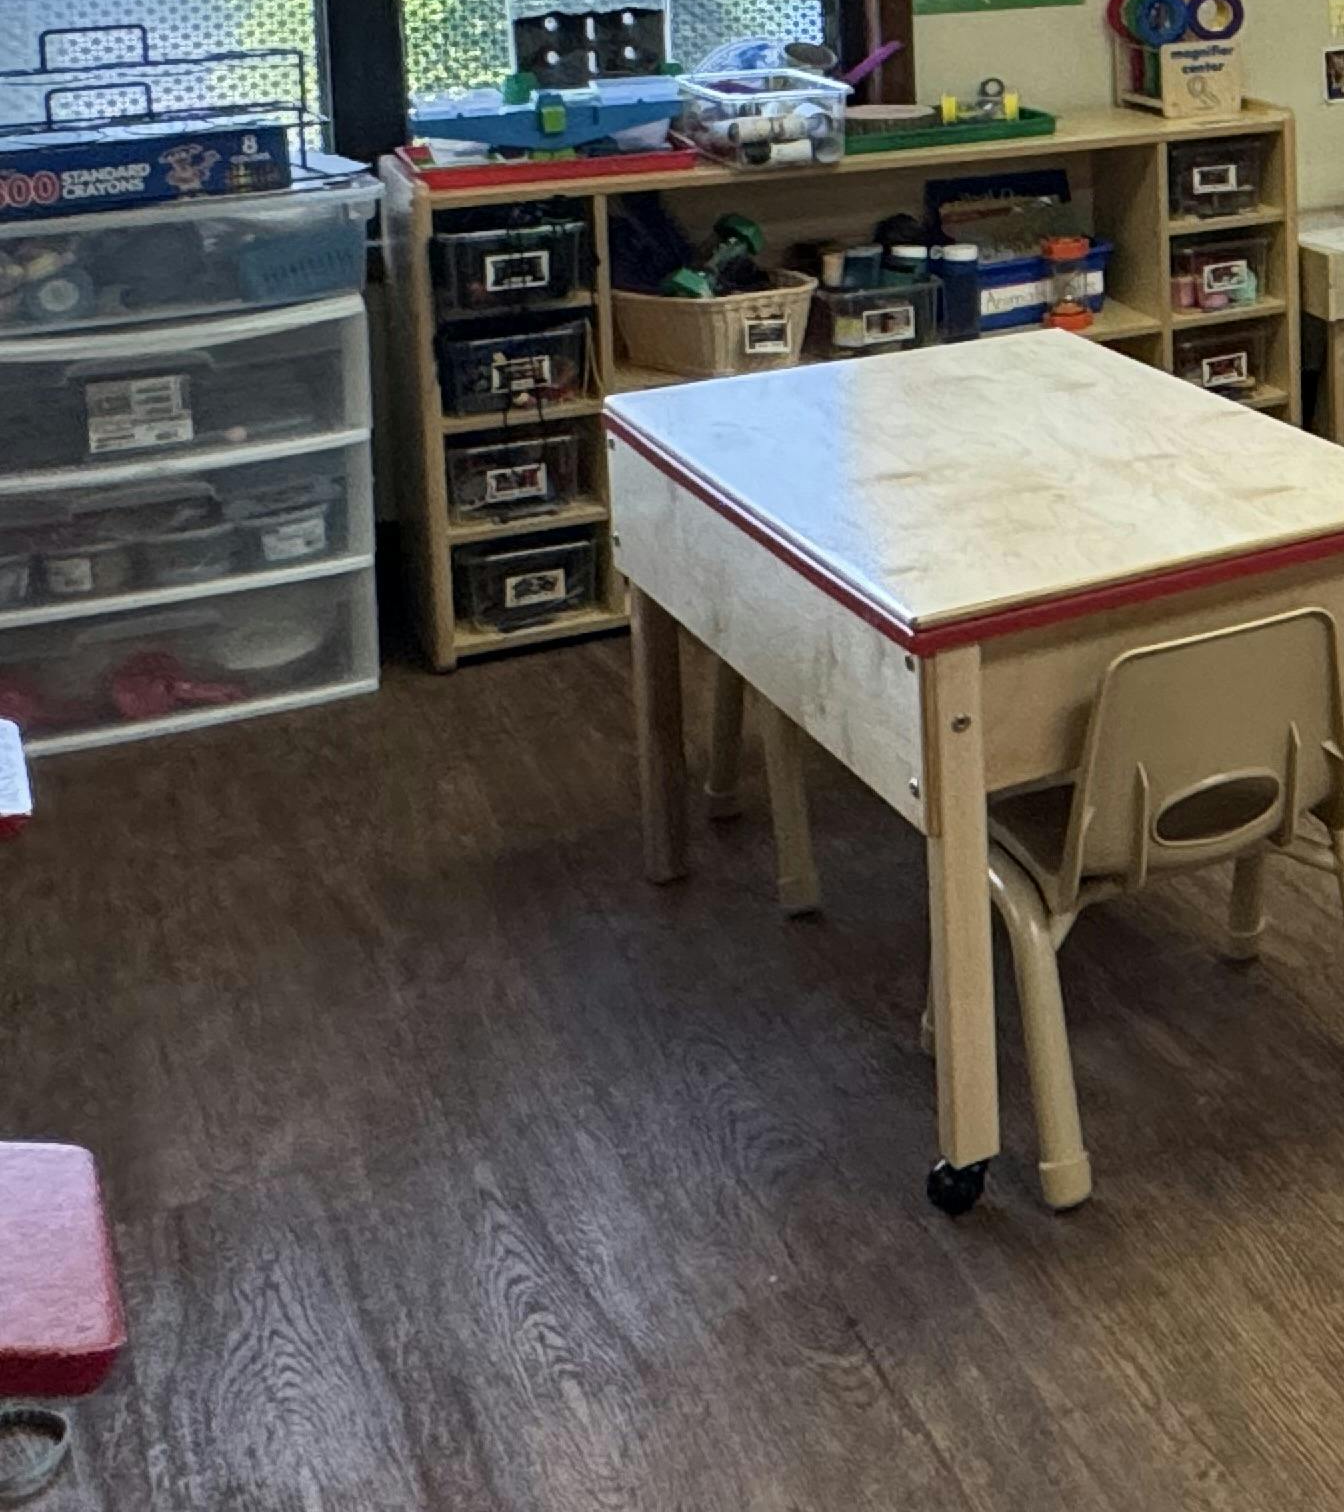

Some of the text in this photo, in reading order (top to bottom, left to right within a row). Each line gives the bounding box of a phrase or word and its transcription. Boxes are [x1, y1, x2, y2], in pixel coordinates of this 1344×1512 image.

[1170, 45, 1234, 61] magnifier
[1182, 62, 1225, 76] center
[61, 163, 151, 185] STANDARD
[62, 178, 145, 200] CRAYONS
